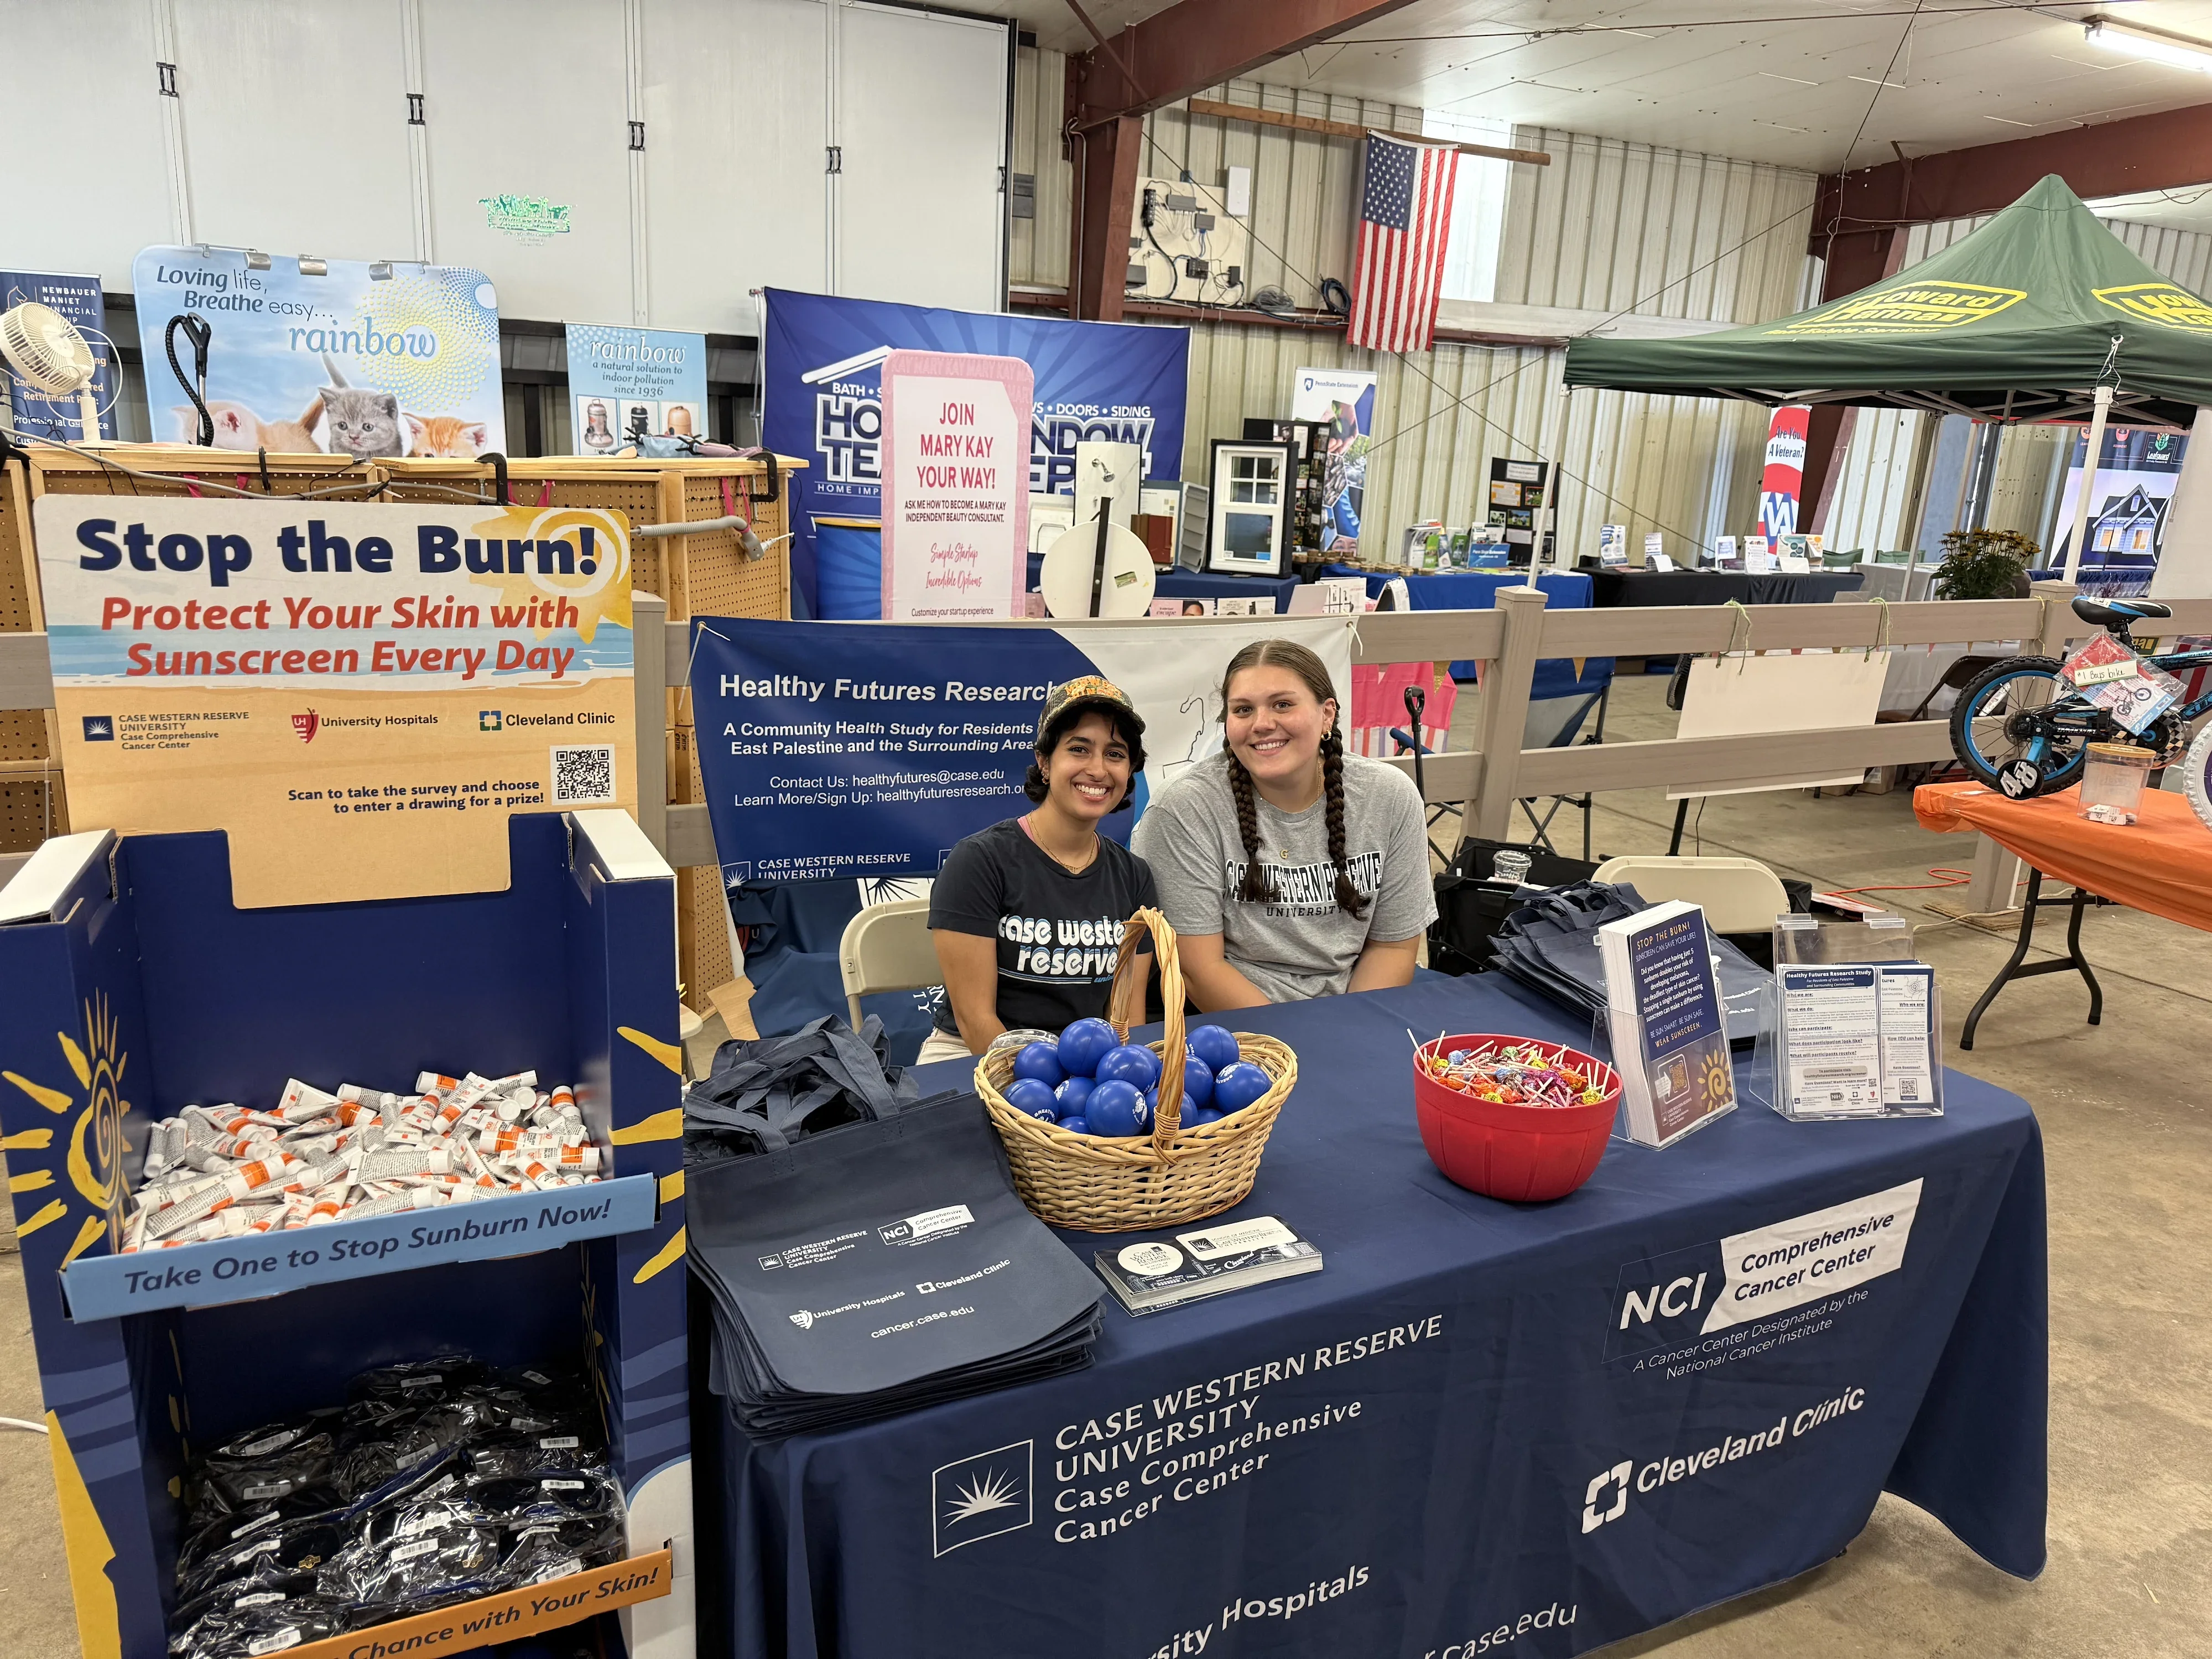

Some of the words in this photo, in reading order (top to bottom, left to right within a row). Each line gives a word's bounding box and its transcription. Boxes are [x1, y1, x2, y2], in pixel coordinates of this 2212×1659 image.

[157, 266, 227, 293] Loving
[233, 269, 267, 294] life,
[43, 287, 96, 297] NEWBAUER
[43, 296, 80, 305] MANIET
[184, 290, 263, 313] Breathe
[269, 302, 332, 321] easy...
[289, 316, 435, 357] rainbow
[590, 335, 686, 364] rainbow
[601, 362, 634, 371] natural
[636, 363, 671, 373] solution
[603, 372, 632, 382] indoor
[634, 374, 674, 386] pollution
[23, 391, 75, 403] Retirement
[639, 386, 663, 398] 1936
[832, 382, 865, 396] BATH
[1056, 403, 1099, 416] DOORS
[1111, 405, 1151, 417] SIDING
[940, 403, 974, 425] JOIN
[1776, 426, 1788, 439] Are
[1789, 427, 1800, 439] You
[921, 434, 962, 456] MARY
[966, 435, 993, 458] KAY
[1768, 444, 1774, 456] A
[1776, 444, 1804, 457] Veteran?
[917, 466, 956, 488] YOUR
[961, 467, 995, 489] WAY!
[904, 500, 916, 509] ASK
[917, 500, 925, 509] ME
[927, 500, 941, 509] HOW
[941, 500, 949, 509] TO
[950, 500, 974, 509] BECOME
[975, 501, 979, 509] A
[979, 501, 995, 510] MARY
[996, 501, 1006, 510] KAY
[906, 513, 946, 522] INDEPENDENT
[946, 513, 967, 522] BEAUTY
[968, 513, 1004, 522] CONSULTANT.
[76, 519, 252, 587] Stop
[277, 520, 393, 573] the
[418, 526, 596, 575] Burn!
[102, 597, 271, 630] Protect
[283, 597, 382, 630] Your
[391, 595, 479, 628] Skin
[490, 595, 579, 628] with
[912, 607, 937, 617] Customize
[938, 609, 949, 618] your
[949, 608, 967, 617] startup
[967, 608, 993, 617] experience
[126, 643, 358, 676] Sunscreen
[371, 641, 486, 680] Every
[496, 640, 574, 679] Day
[2107, 668, 2125, 678] bike
[721, 674, 825, 702] Healthy
[835, 679, 936, 701] Futures
[120, 722, 186, 731] UNIVERSITY
[321, 717, 381, 727] University
[386, 714, 438, 726] Hospitals
[506, 713, 573, 726] Cleveland
[577, 713, 615, 724] Clinic
[724, 722, 736, 736] A
[741, 722, 831, 737] Community
[836, 721, 884, 734] Health
[889, 723, 934, 738] Study
[938, 724, 959, 735] for
[963, 723, 1033, 735] Residents
[146, 731, 219, 741] Comprehensive
[732, 742, 768, 755] East
[773, 741, 843, 755] Palestine
[847, 739, 874, 752] and
[879, 740, 903, 751] the
[908, 740, 998, 753] Surrounding
[1001, 739, 1033, 750] Area
[770, 776, 823, 788] Contact
[827, 776, 848, 787] Us:
[853, 768, 1004, 787] healthyfutures@case.edu
[289, 790, 322, 800] Scan
[327, 789, 342, 799] to
[347, 786, 378, 798] take
[383, 785, 407, 796] the
[412, 786, 457, 796] survey
[462, 781, 487, 792] and
[492, 780, 539, 791] choose
[735, 794, 773, 806] Learn
[779, 793, 846, 807] More/Sign
[852, 792, 872, 805] Up:
[334, 804, 348, 813] to
[354, 802, 392, 812] enter
[409, 797, 466, 810] drawing
[470, 795, 490, 806] for
[507, 793, 544, 808] prize!
[758, 859, 790, 869] CASE
[794, 855, 853, 867] WESTERN
[857, 854, 910, 864] RESERVE
[758, 868, 836, 880] UNIVERSITY
[1267, 905, 1343, 917] UNIVERSITY
[1637, 936, 1653, 950] STOP
[1656, 930, 1667, 942] THE
[1670, 921, 1690, 936] BURN!
[124, 1266, 201, 1294] Take
[213, 1257, 277, 1280] One
[287, 1250, 319, 1267] to
[329, 1237, 399, 1261] Stop
[408, 1218, 528, 1249] Sunburn
[538, 1198, 611, 1229] Now!
[1741, 1214, 1894, 1273] Comprehensive
[1224, 1251, 1255, 1270] Cleveland
[935, 1271, 983, 1288] Cleveland
[983, 1260, 1010, 1274] Clinic
[1735, 1268, 1806, 1301] Cancer
[1811, 1245, 1876, 1277] Center
[813, 1303, 861, 1318] University
[862, 1291, 905, 1306] Hospitals
[1620, 1272, 1707, 1329] NCI
[871, 1307, 975, 1338] cancer.case.edu
[1056, 1404, 1143, 1450] CASE
[1153, 1353, 1305, 1424] WESTERN
[1314, 1314, 1442, 1370] RESERVE
[1055, 1395, 1261, 1483] UNIVERSITY
[1637, 1416, 1787, 1492] Cleveland
[1793, 1386, 1865, 1437] Clinic
[1055, 1481, 1130, 1512] Case
[1140, 1400, 1362, 1486] Comprehensive
[1055, 1489, 1162, 1542] Cancer
[1174, 1451, 1269, 1501] Center
[1222, 1566, 1368, 1631] Hospitals
[349, 1628, 454, 1659] Chance
[463, 1606, 520, 1634] with
[531, 1590, 590, 1616] Your
[595, 1567, 658, 1598] Skin!
